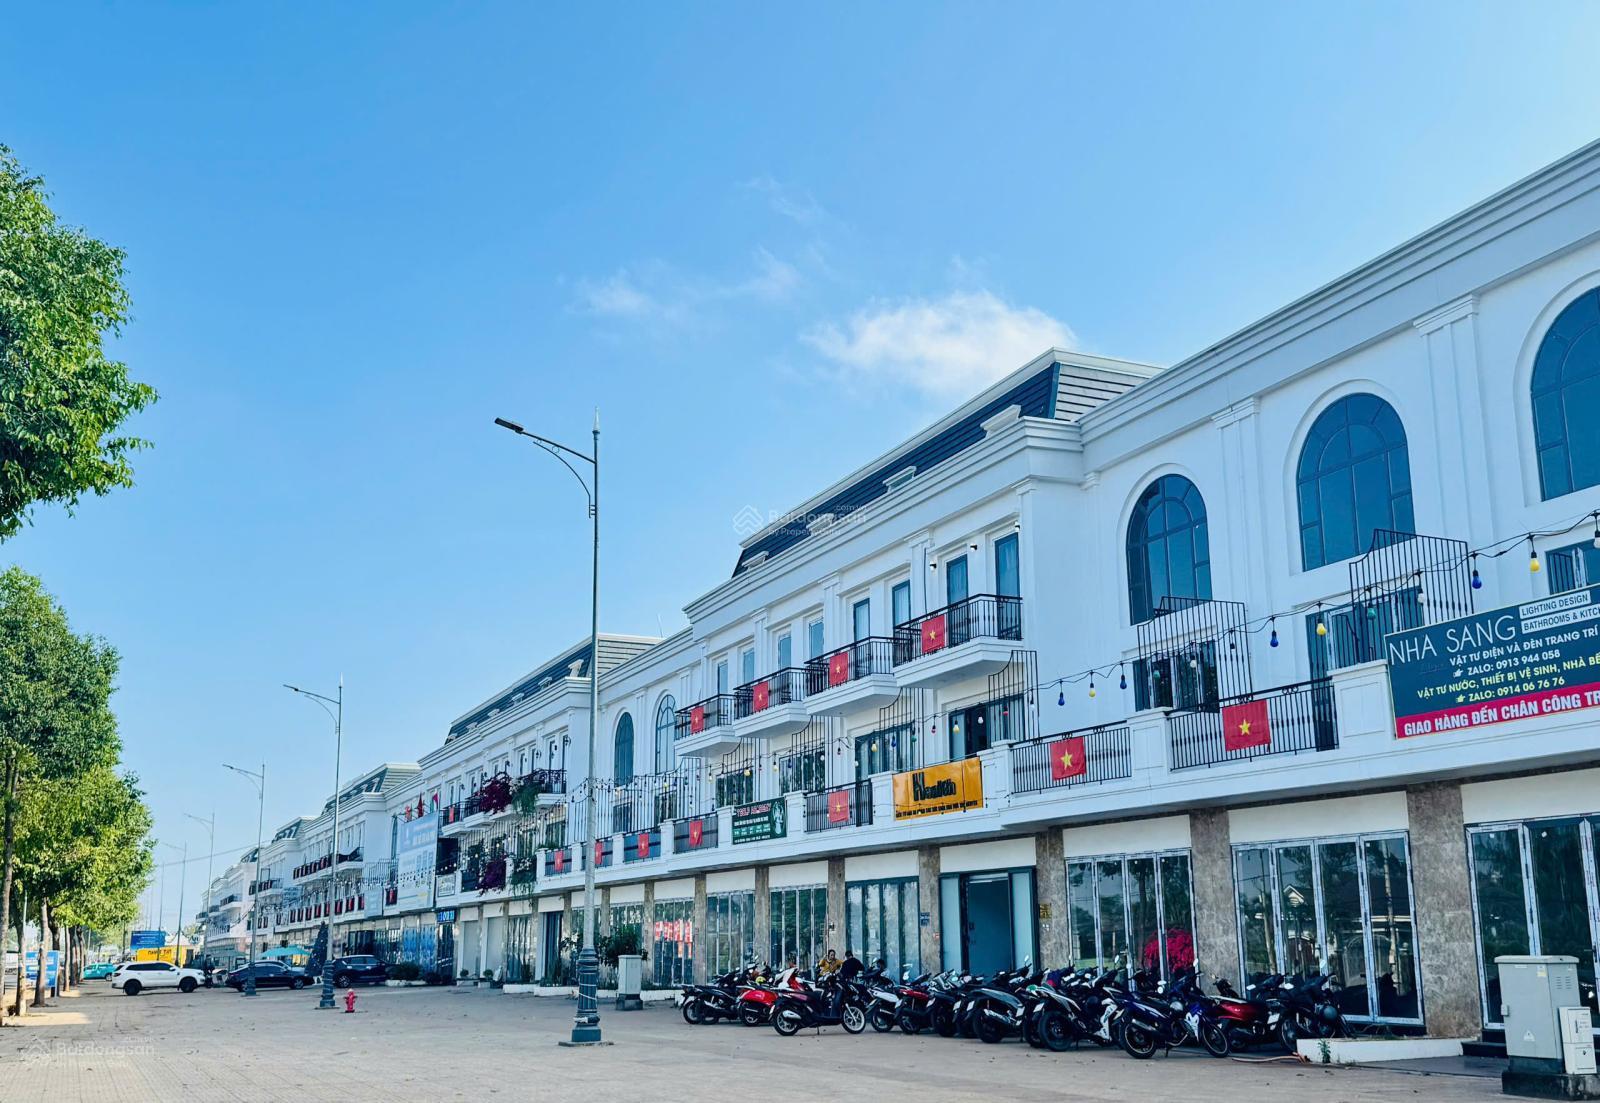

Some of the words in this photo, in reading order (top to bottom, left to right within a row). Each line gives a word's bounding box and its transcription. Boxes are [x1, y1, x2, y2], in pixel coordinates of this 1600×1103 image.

[1521, 601, 1557, 616] LIGHTING
[1559, 593, 1588, 608] DESIGN
[1523, 613, 1571, 631] BATHROOMS
[1572, 611, 1578, 620] &
[1449, 654, 1467, 667] VẬT
[1469, 650, 1480, 662] TƯ
[1482, 646, 1505, 660] ĐIỆN
[1506, 641, 1521, 655] VÀ
[1523, 638, 1543, 651] ĐÈN
[1545, 631, 1580, 647] TRANG
[1582, 624, 1599, 639] TRÍ
[1467, 662, 1494, 676] ZALO:
[1496, 657, 1520, 670] 0913
[1521, 653, 1540, 664] 944
[1542, 649, 1561, 661] 058
[1417, 686, 1434, 699] VẬT
[1436, 685, 1448, 695] TƯ
[1481, 672, 1505, 687] THIẾT
[1507, 673, 1517, 682] BỊ
[1519, 667, 1531, 679] VỆ
[1533, 663, 1561, 676] SINH,
[1563, 656, 1586, 671] NHÀ
[1469, 689, 1495, 702] ZALO:
[1497, 684, 1520, 697] 0914
[1522, 682, 1535, 692] 06
[1537, 679, 1550, 689] 76
[1552, 676, 1565, 687] 76
[1404, 720, 1431, 736] GIAO
[1435, 712, 1469, 731] HÀNG
[1471, 705, 1498, 725] ĐẾN
[1501, 700, 1539, 720] CHÂN
[1541, 693, 1582, 713] CÔNG
